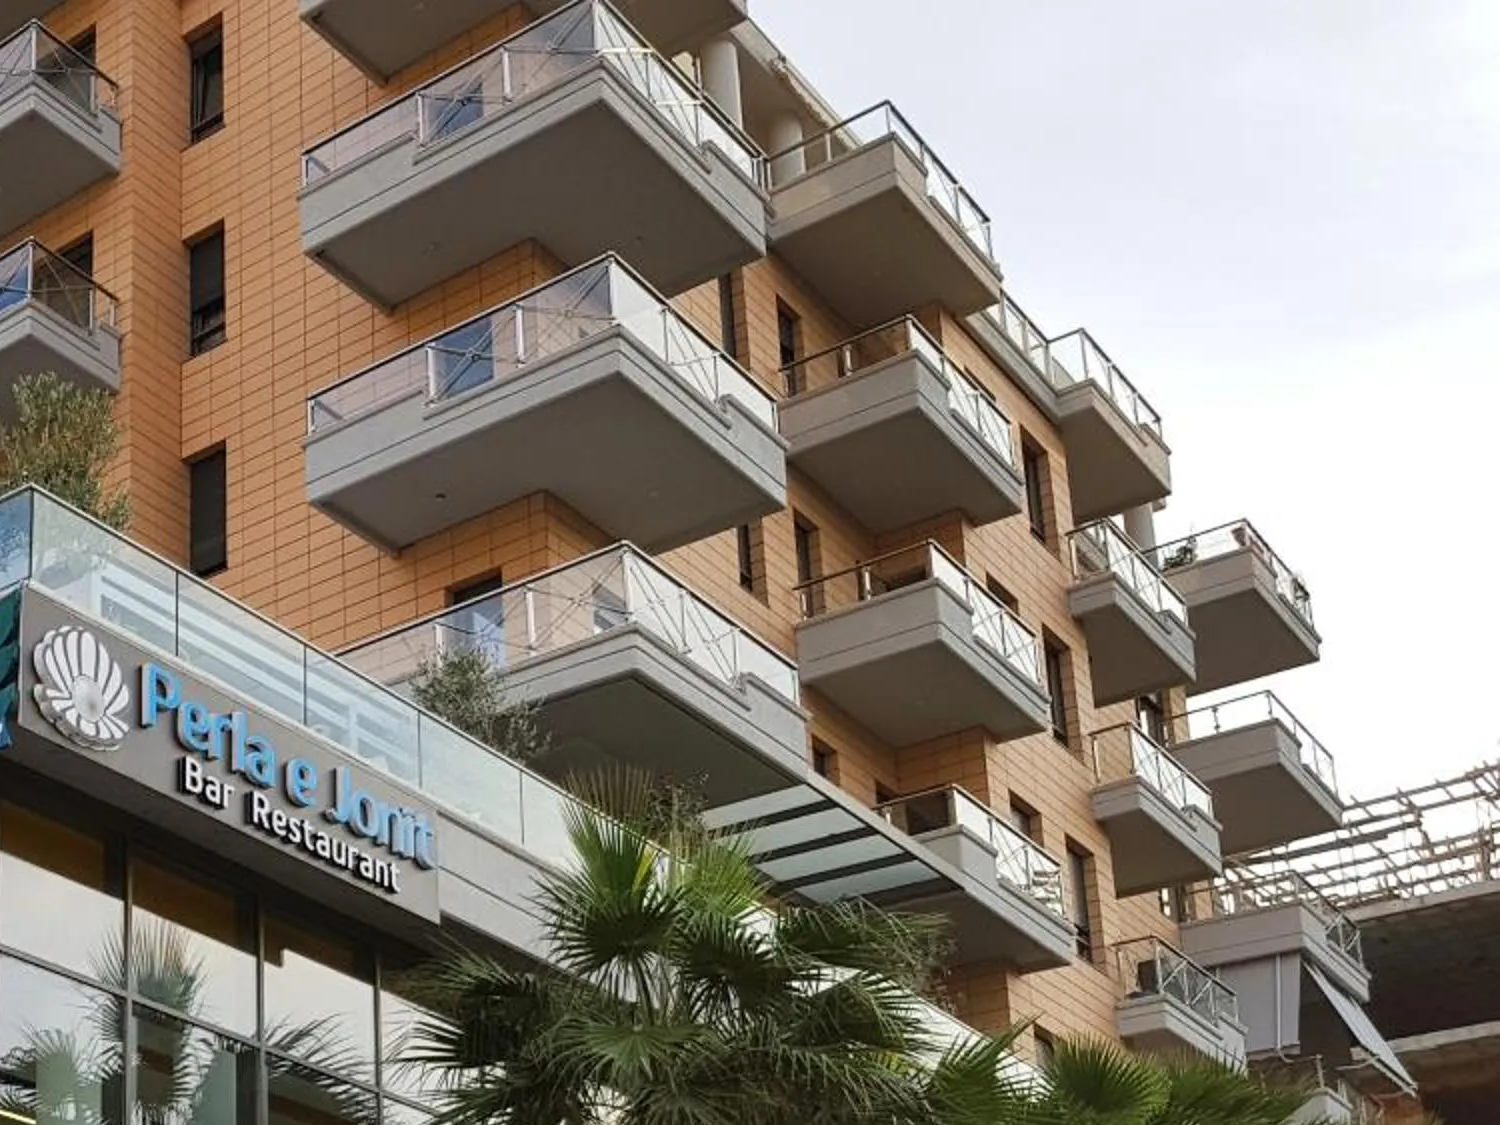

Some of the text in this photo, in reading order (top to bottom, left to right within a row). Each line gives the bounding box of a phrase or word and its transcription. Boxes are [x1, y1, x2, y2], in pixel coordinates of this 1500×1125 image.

[140, 660, 276, 789] Perla
[285, 757, 317, 808] e
[180, 755, 402, 895] Bar Restaurant
